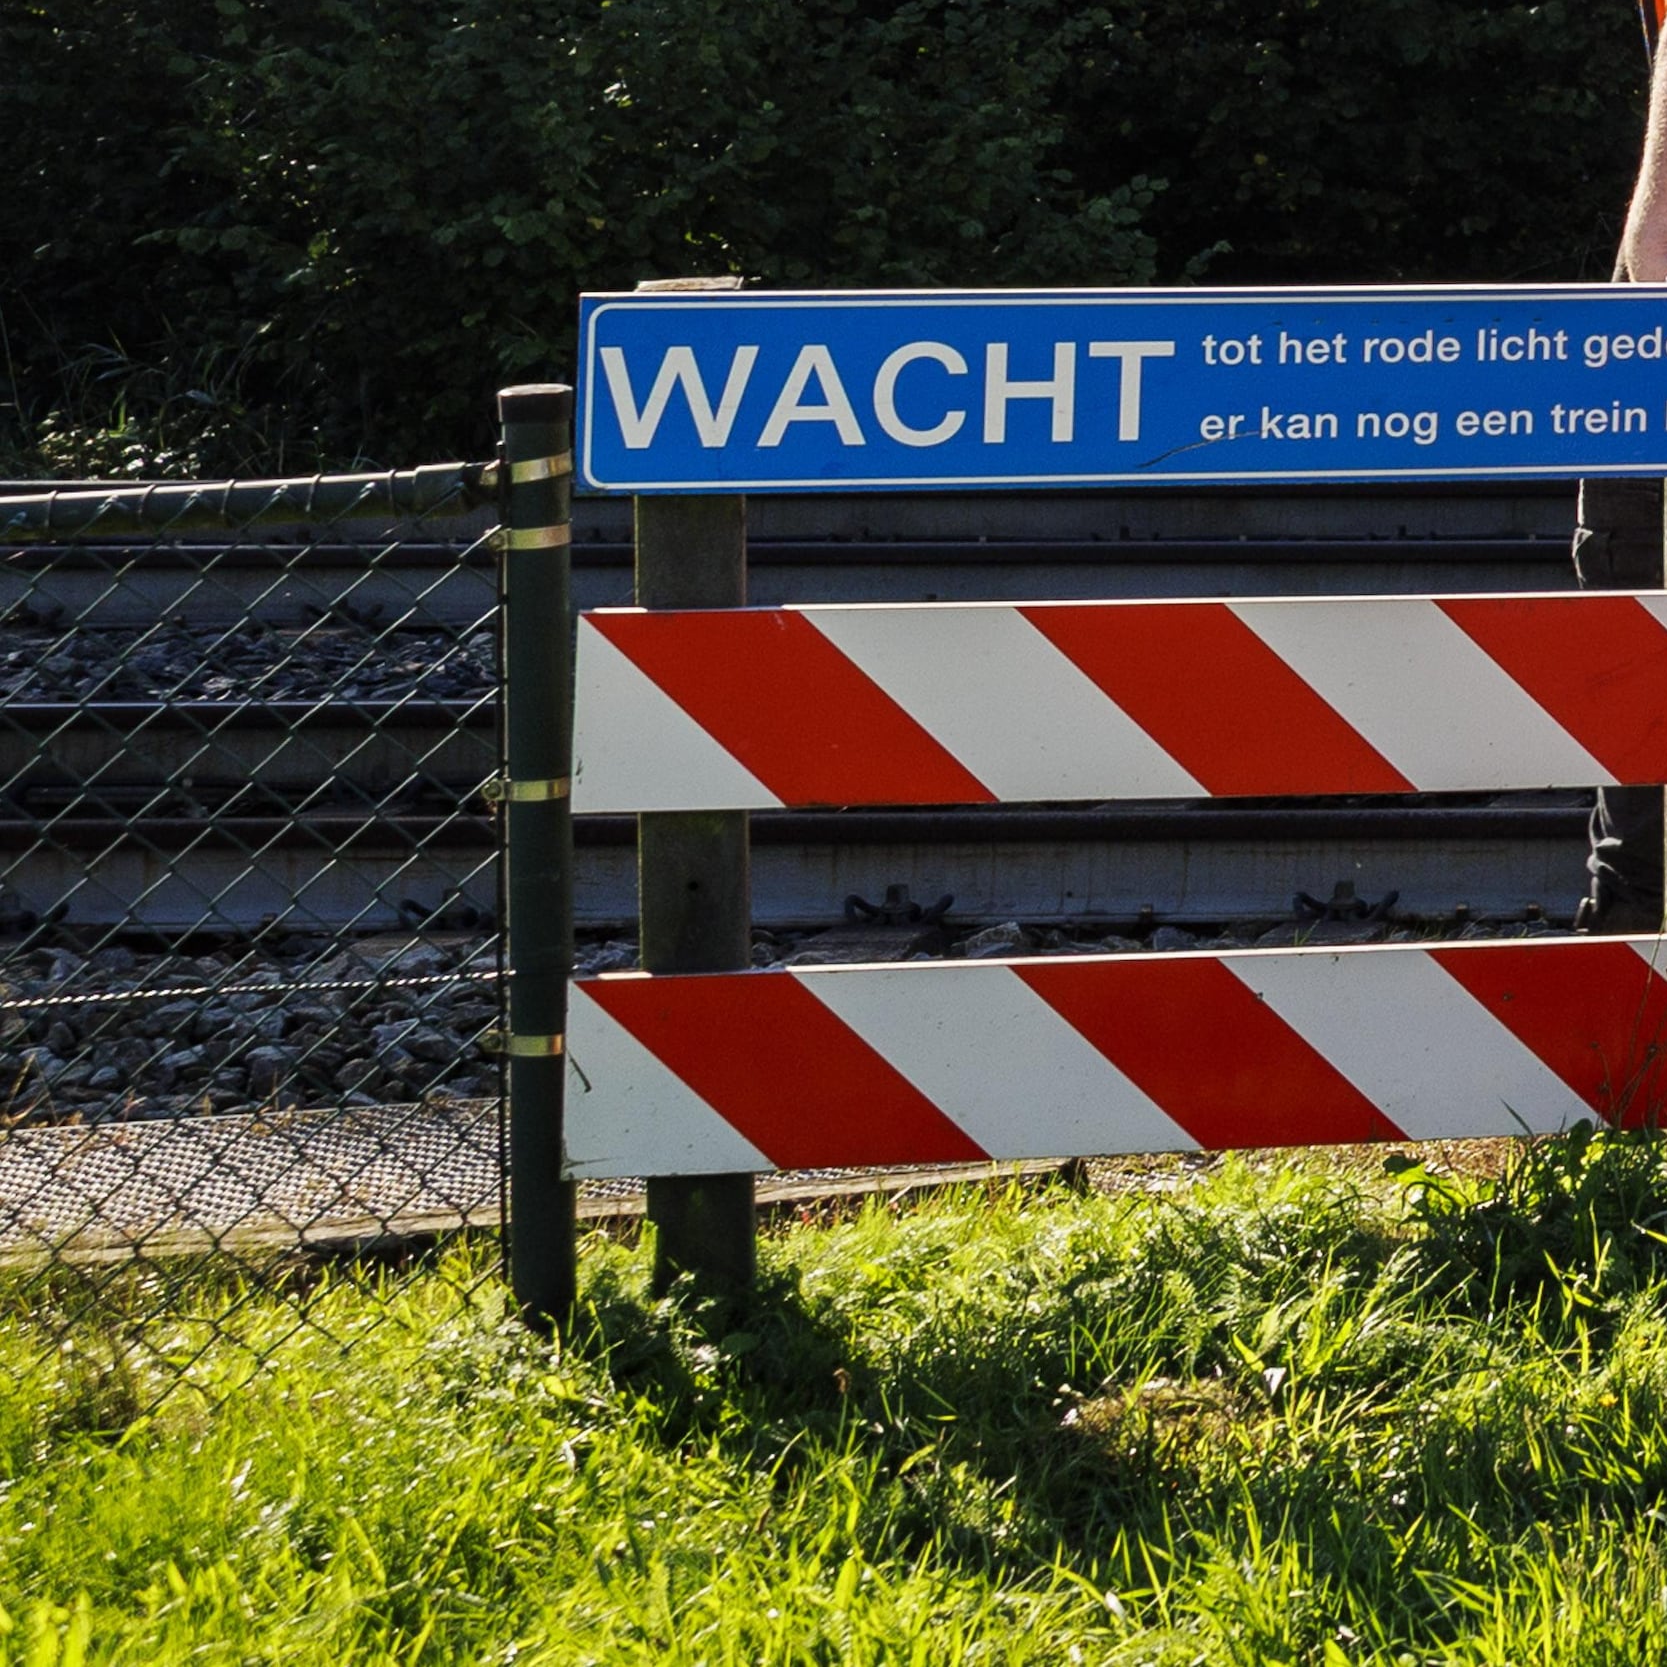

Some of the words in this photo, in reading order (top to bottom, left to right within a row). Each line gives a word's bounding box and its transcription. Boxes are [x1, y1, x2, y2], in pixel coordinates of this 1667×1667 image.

[1202, 335, 1262, 365] tot
[1279, 331, 1347, 364] het
[1364, 330, 1460, 363] rode
[1478, 328, 1568, 361] licht
[600, 341, 1176, 449] WACHT
[1200, 415, 1245, 440] er
[1261, 406, 1337, 439] kan
[1357, 412, 1438, 445] nog
[1456, 410, 1533, 436] een
[1551, 400, 1647, 434] trein
